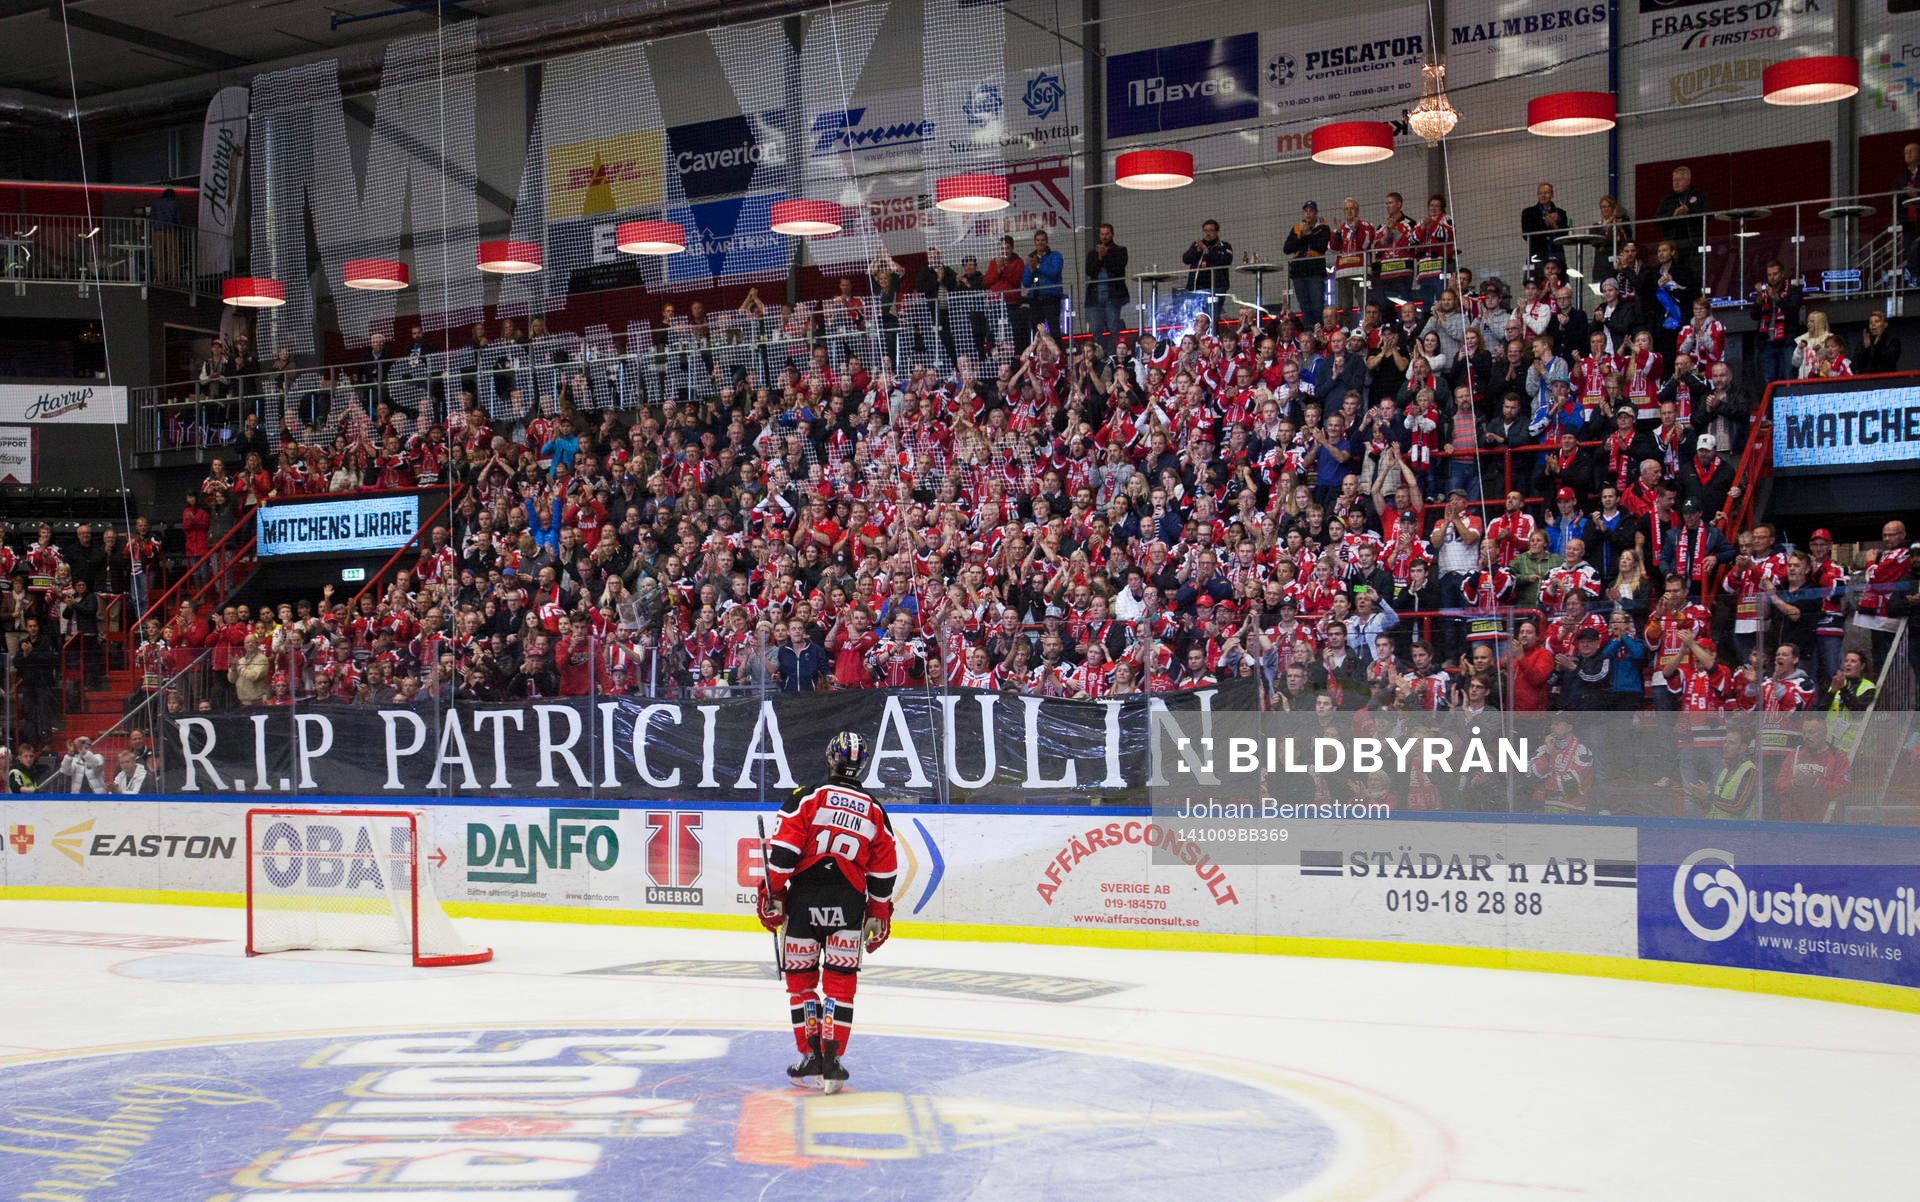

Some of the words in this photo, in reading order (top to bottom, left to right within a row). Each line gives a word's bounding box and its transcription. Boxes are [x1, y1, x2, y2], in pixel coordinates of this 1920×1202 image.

[1451, 4, 1607, 45] MALMBERGS
[1652, 7, 1748, 36] FRASSES
[1305, 35, 1424, 71] PISCATOR
[1306, 60, 1396, 80] ventilation
[1166, 77, 1235, 101] BYGG
[676, 140, 780, 174] Caverion
[204, 127, 234, 227] Harrys
[25, 388, 93, 419] Harrys
[263, 515, 350, 544] MATCHENS
[354, 509, 412, 538] LIRARE
[175, 713, 334, 791] R.I.P
[377, 700, 798, 789] PATRICIA
[861, 689, 1219, 788] AULIN
[829, 792, 866, 814] ÖBAB
[89, 834, 237, 859] EASTON
[467, 820, 620, 873] DANFO
[1036, 821, 1239, 907] AFFÄRSCONSULT
[1541, 857, 1589, 886] AB
[565, 892, 620, 902] www.danfo.com
[648, 887, 700, 903] ÖREBRO
[1100, 883, 1151, 894] SVERIGE
[1154, 884, 1171, 894] AB
[1104, 898, 1167, 910] 019-184570
[1386, 889, 1468, 914] 019-18
[1477, 890, 1506, 915] 28
[1514, 891, 1543, 916] 88
[808, 906, 847, 927] NA
[1073, 913, 1200, 927] www.affarsconsult.se
[1758, 935, 1902, 961] www.gustavsvik.se
